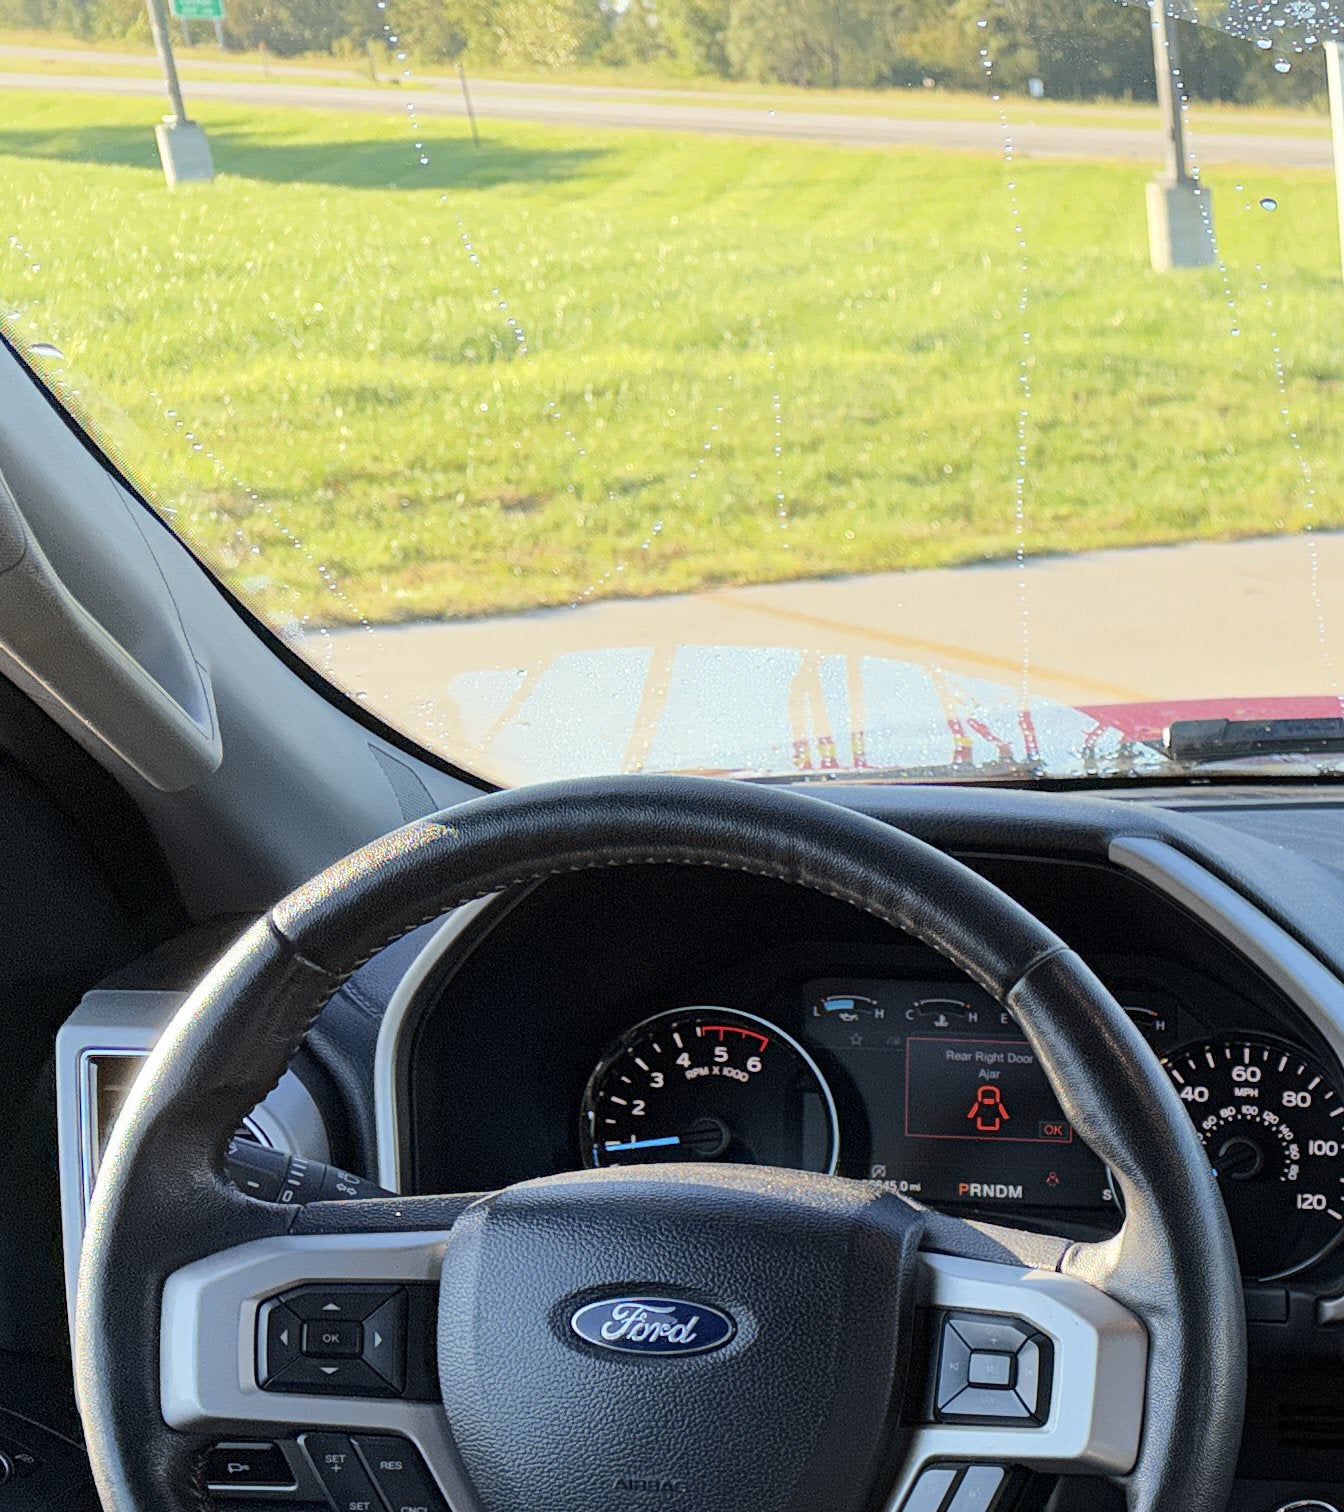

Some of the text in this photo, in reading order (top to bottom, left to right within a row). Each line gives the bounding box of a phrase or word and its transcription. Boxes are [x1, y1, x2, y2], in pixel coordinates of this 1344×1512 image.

[1156, 1020, 1165, 1031] H
[676, 1052, 692, 1068] 4
[714, 1046, 729, 1062] 5
[946, 1050, 1034, 1064] Rear Right Door
[746, 1056, 762, 1073] 6
[650, 1072, 664, 1088] 3
[685, 1066, 709, 1080] RPM
[722, 1066, 750, 1083] 1000
[978, 1069, 1001, 1081] Ajar
[1231, 1065, 1261, 1083] 60
[1180, 1086, 1209, 1103] 40
[1234, 1087, 1259, 1097] MPH
[1282, 1091, 1312, 1108] 80
[631, 1100, 646, 1115] 2
[1241, 1104, 1259, 1115] 100
[1262, 1110, 1279, 1125] 120
[1043, 1124, 1063, 1136] OK
[1308, 1139, 1339, 1157] 100
[1297, 1193, 1327, 1210] 120
[601, 1303, 697, 1345] Ford
[321, 1333, 340, 1343] OK
[325, 1454, 346, 1463] SET
[380, 1461, 402, 1470] RES
[349, 1502, 370, 1511] SET
